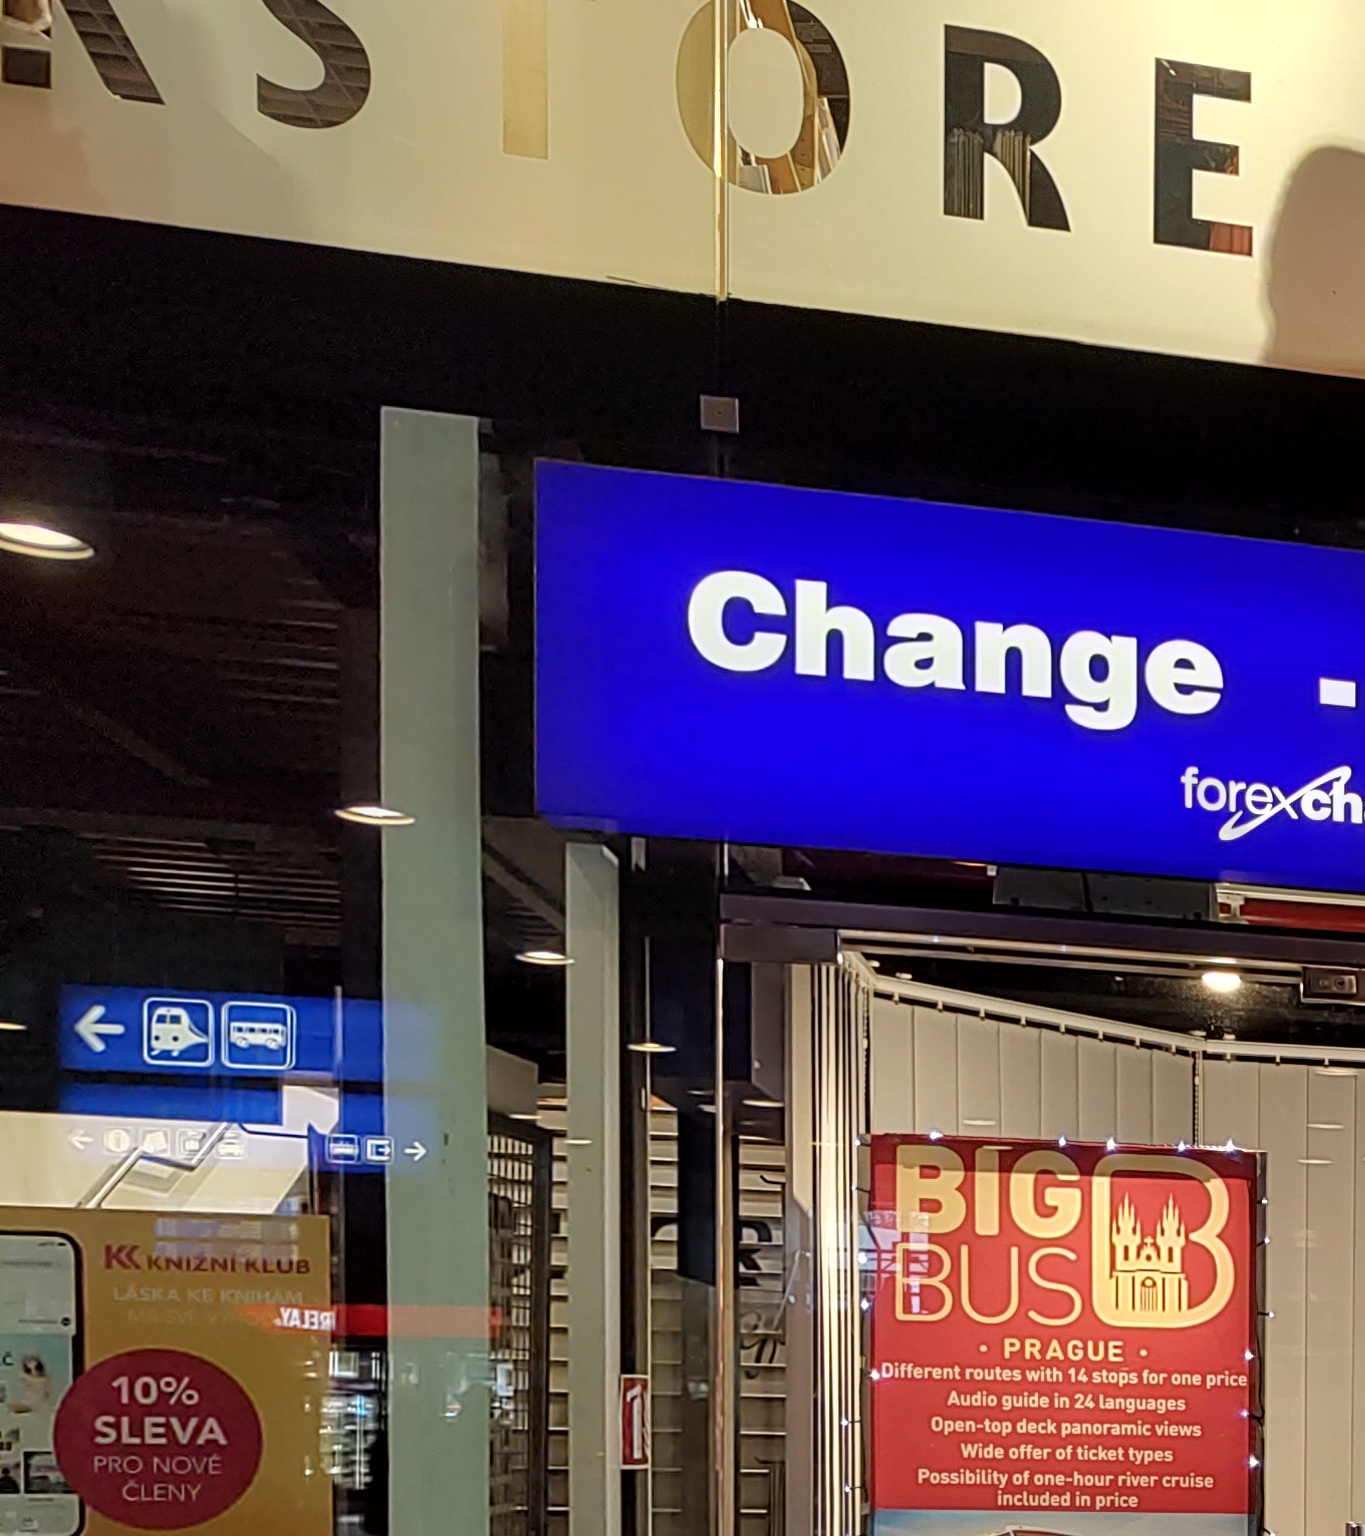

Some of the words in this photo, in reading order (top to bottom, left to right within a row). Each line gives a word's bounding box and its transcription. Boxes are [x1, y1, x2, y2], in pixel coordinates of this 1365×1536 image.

[685, 570, 1226, 731] Change
[895, 1144, 1083, 1239] BIG
[244, 1258, 312, 1275] KLUB
[113, 1284, 180, 1303] LÁSKA
[187, 1287, 214, 1303] KE
[895, 1242, 1083, 1326] BUS
[1003, 1338, 1125, 1363] PRAGUE
[881, 1363, 961, 1382] Different
[965, 1366, 1022, 1382] routes
[1025, 1366, 1063, 1384] with
[1067, 1367, 1089, 1384] 14
[1091, 1368, 1138, 1388] stops
[1142, 1369, 1167, 1386] for
[1170, 1372, 1203, 1387] one
[1206, 1371, 1248, 1391] price
[111, 1375, 200, 1407] 10%
[947, 1391, 998, 1408] Audio
[1001, 1391, 1050, 1412] guide
[1053, 1392, 1070, 1409] in
[1074, 1394, 1096, 1410] 24
[1099, 1394, 1187, 1415] languages
[93, 1414, 228, 1448] SLEVA
[930, 1417, 1013, 1437] Open-top
[1016, 1418, 1058, 1435] deck
[1061, 1420, 1151, 1440] panoramic
[1154, 1422, 1203, 1438] views
[93, 1455, 144, 1477] PRO
[152, 1449, 223, 1477] NOVÉ
[960, 1443, 1005, 1460] Wide
[1008, 1444, 1052, 1461] offer
[1055, 1445, 1073, 1461] of
[1076, 1446, 1124, 1463] ticket
[1127, 1447, 1174, 1466] types
[121, 1475, 203, 1504] ČLENY
[917, 1469, 1008, 1489] Possibility
[1012, 1470, 1031, 1486] of
[1034, 1471, 1114, 1488] one-hour
[1117, 1473, 1159, 1488] river
[1162, 1473, 1215, 1489] cruise
[996, 1490, 1072, 1508] included
[1075, 1492, 1091, 1508] in
[1095, 1493, 1139, 1511] price
